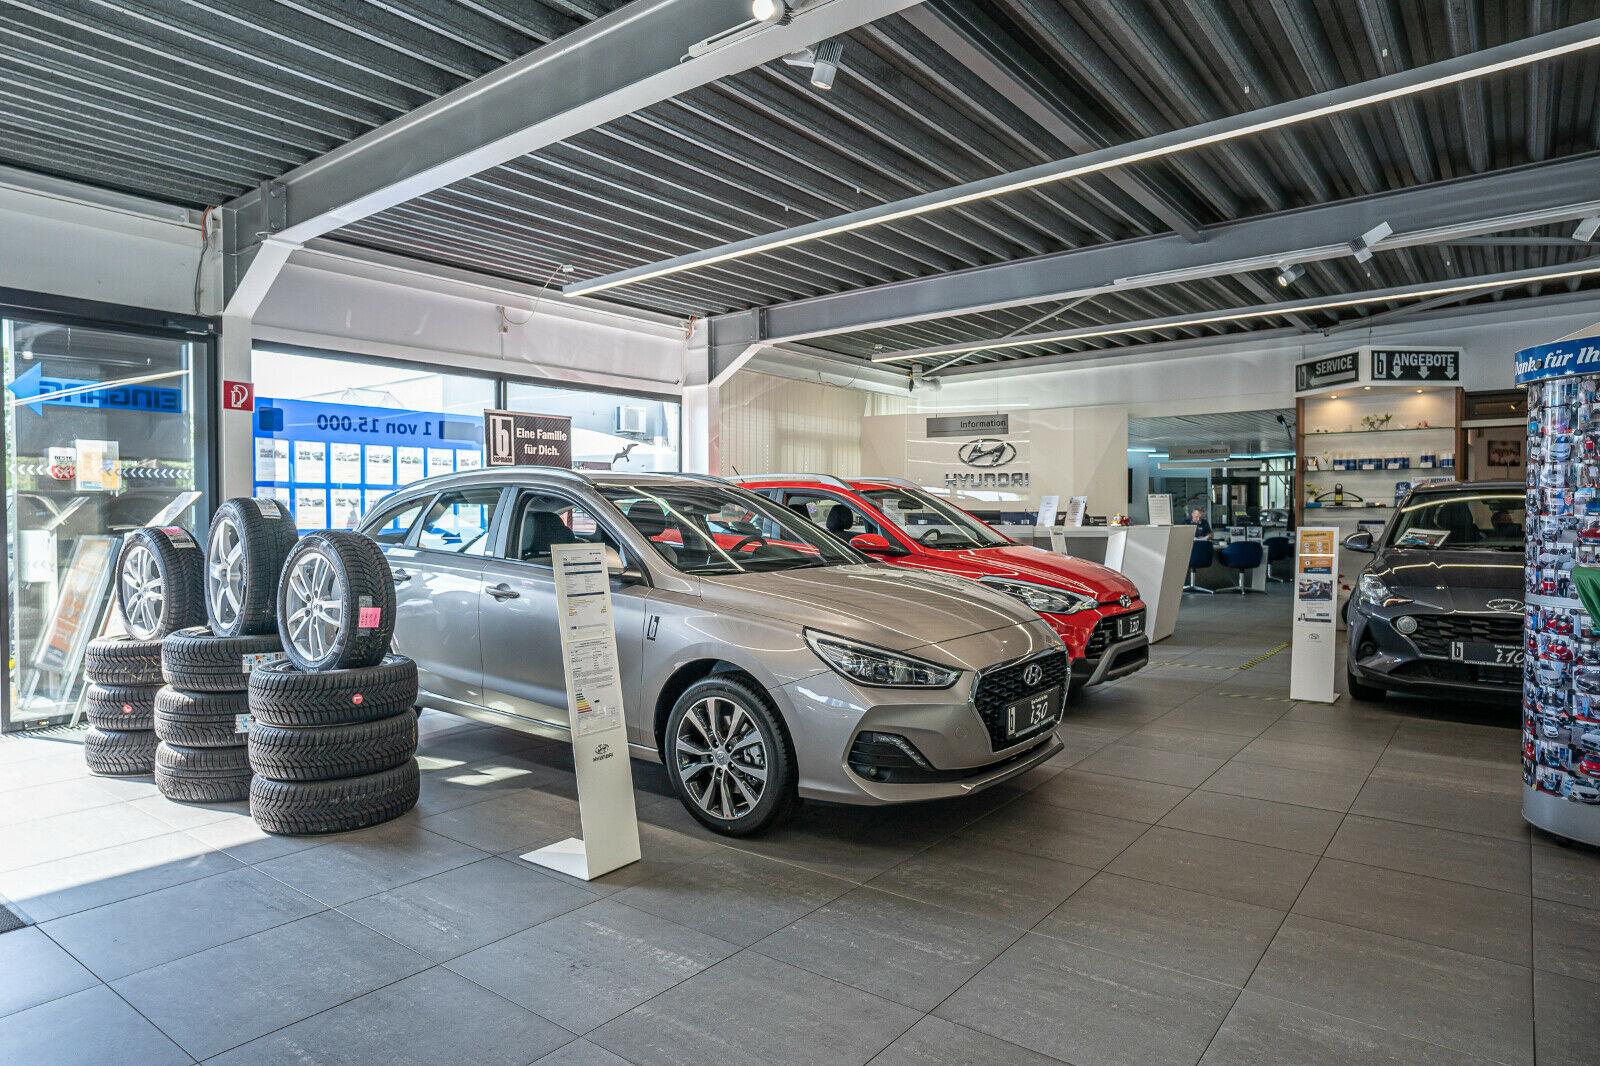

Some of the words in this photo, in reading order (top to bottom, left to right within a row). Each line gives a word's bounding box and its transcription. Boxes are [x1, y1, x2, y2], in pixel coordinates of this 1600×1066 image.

[1315, 356, 1353, 375] SERVICE
[1392, 353, 1455, 367] ANGEBOTE
[1544, 350, 1573, 369] für
[960, 420, 1007, 429] Information
[516, 427, 536, 440] Eine
[537, 429, 568, 441] Familie
[524, 443, 537, 455] für
[538, 444, 560, 456] Dich.
[944, 472, 1030, 487] HYUNDAI
